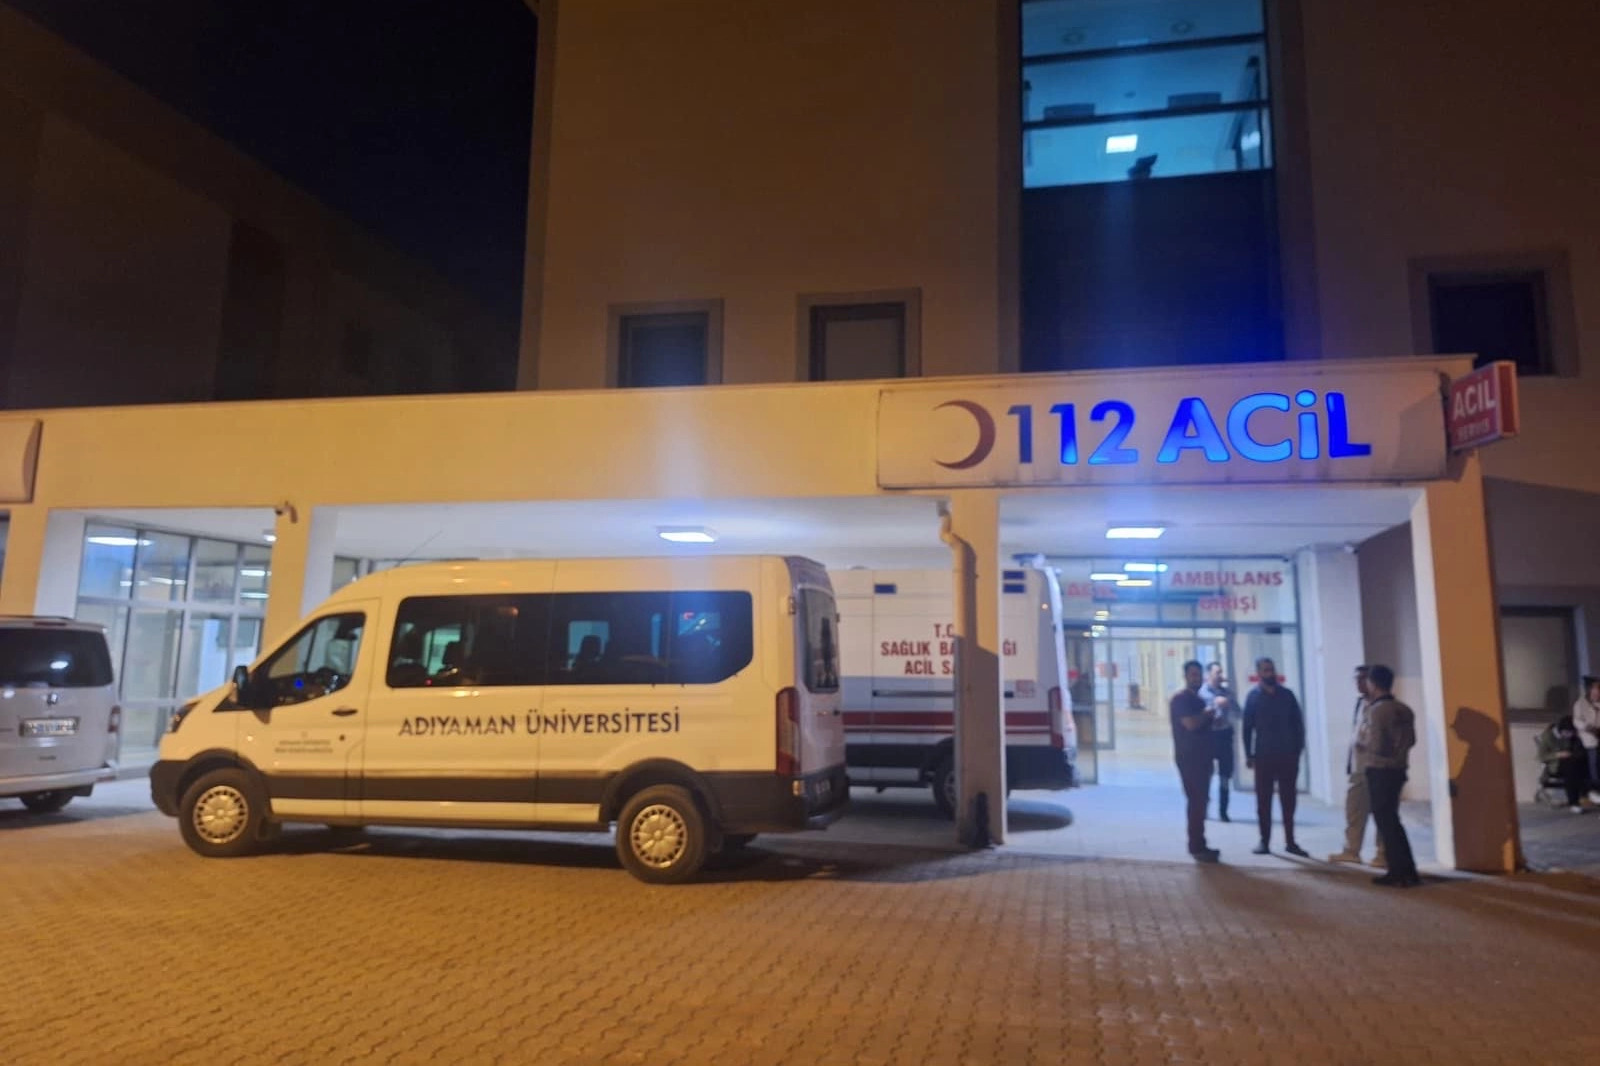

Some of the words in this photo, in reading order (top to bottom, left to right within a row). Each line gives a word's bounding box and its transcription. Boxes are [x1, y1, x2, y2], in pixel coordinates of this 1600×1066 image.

[1007, 399, 1138, 465] 112
[1171, 570, 1284, 587] AMBULANS
[880, 639, 931, 657] SAĞLIK
[904, 658, 936, 675] ACİL
[398, 714, 516, 737] ADIYAMAN
[525, 706, 680, 735] ÜNİVERSİTESİ
